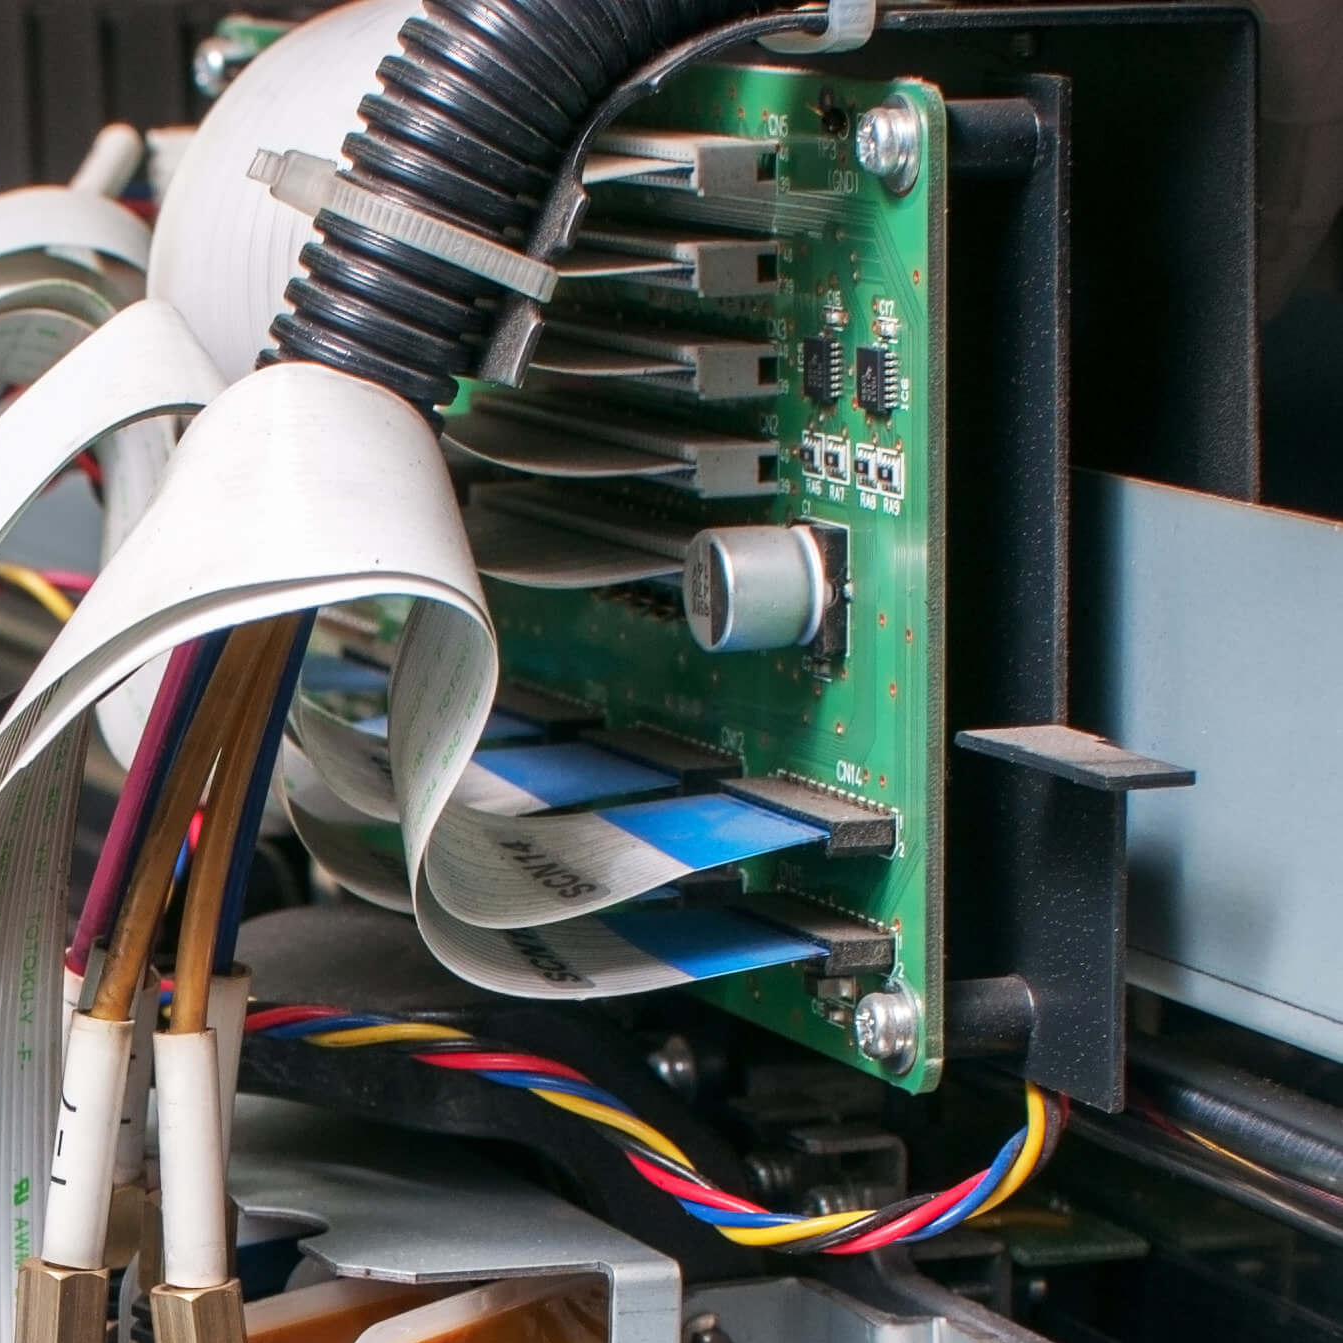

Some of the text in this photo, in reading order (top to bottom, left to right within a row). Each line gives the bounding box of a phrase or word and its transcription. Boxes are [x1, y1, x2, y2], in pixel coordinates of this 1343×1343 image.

[879, 300, 895, 316] C17
[829, 485, 845, 501] RA7
[883, 496, 901, 517] RA9
[836, 760, 863, 787] CN14
[898, 842, 906, 858] 2
[499, 839, 597, 899] SCN14
[20, 911, 42, 1025] TOTOKU-Y
[897, 962, 905, 978] 2
[18, 1041, 33, 1072] -F-
